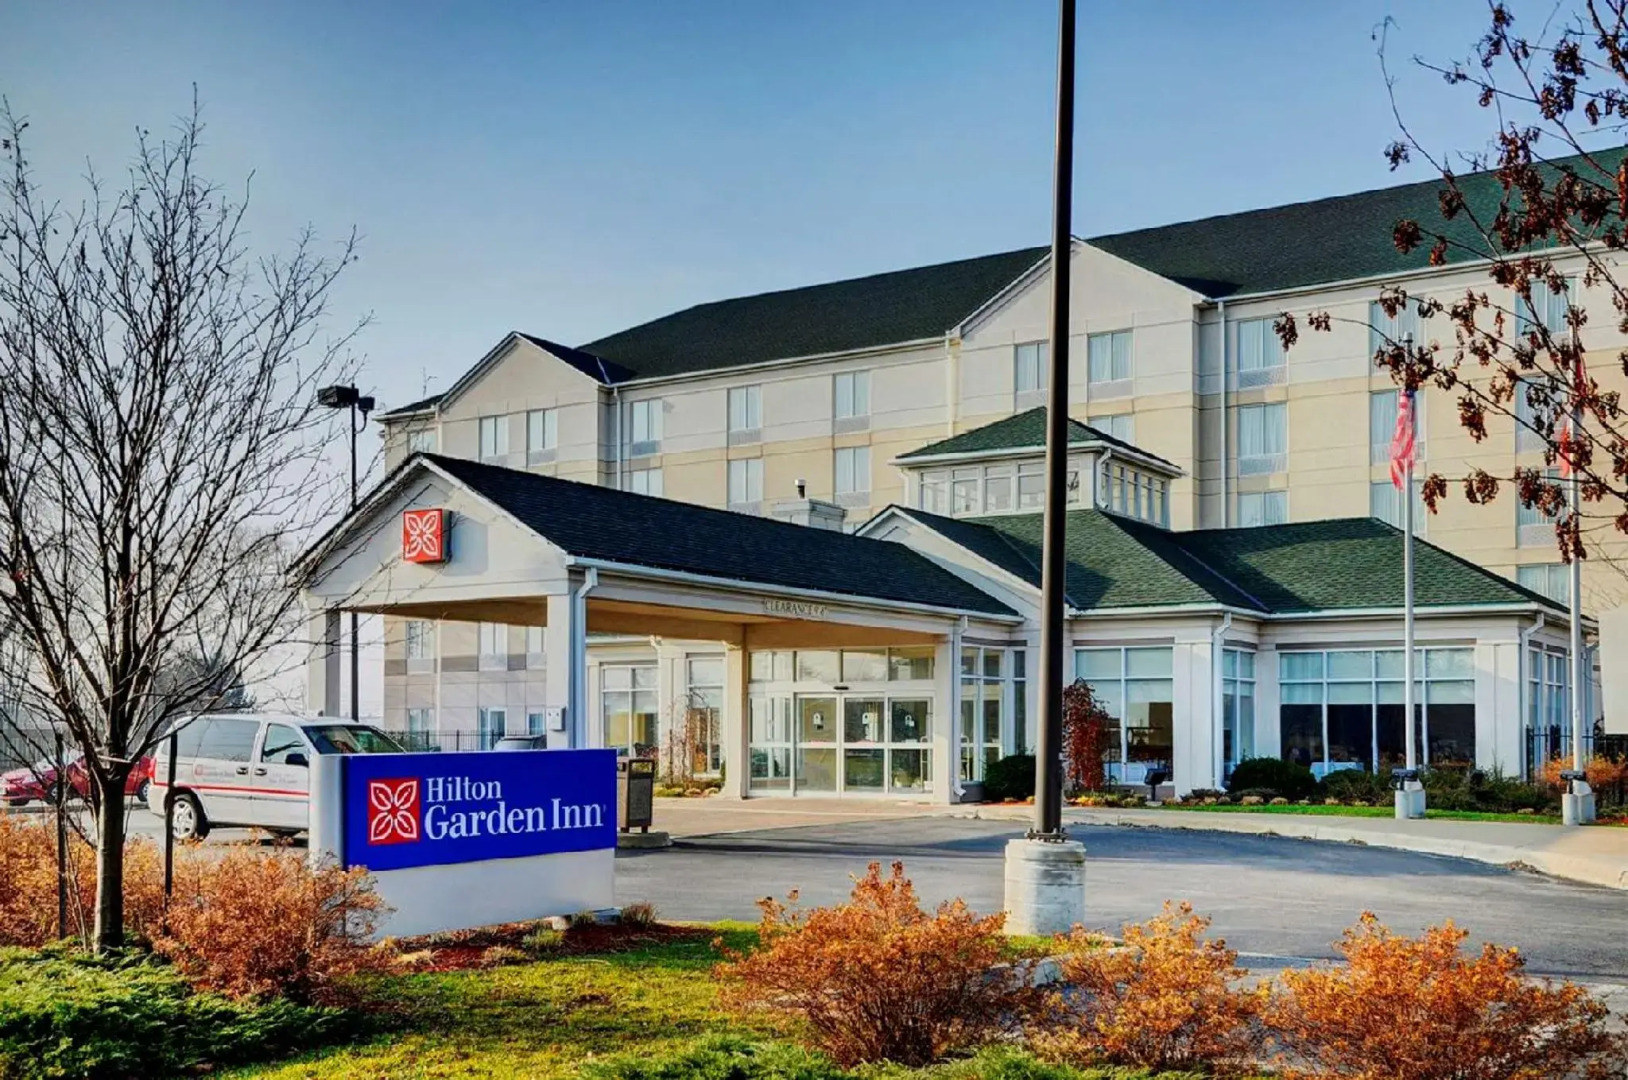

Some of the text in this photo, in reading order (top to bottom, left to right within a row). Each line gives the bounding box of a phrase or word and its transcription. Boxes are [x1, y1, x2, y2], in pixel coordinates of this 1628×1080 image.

[426, 776, 503, 802] Hilton
[424, 798, 604, 840] Garden Inn
